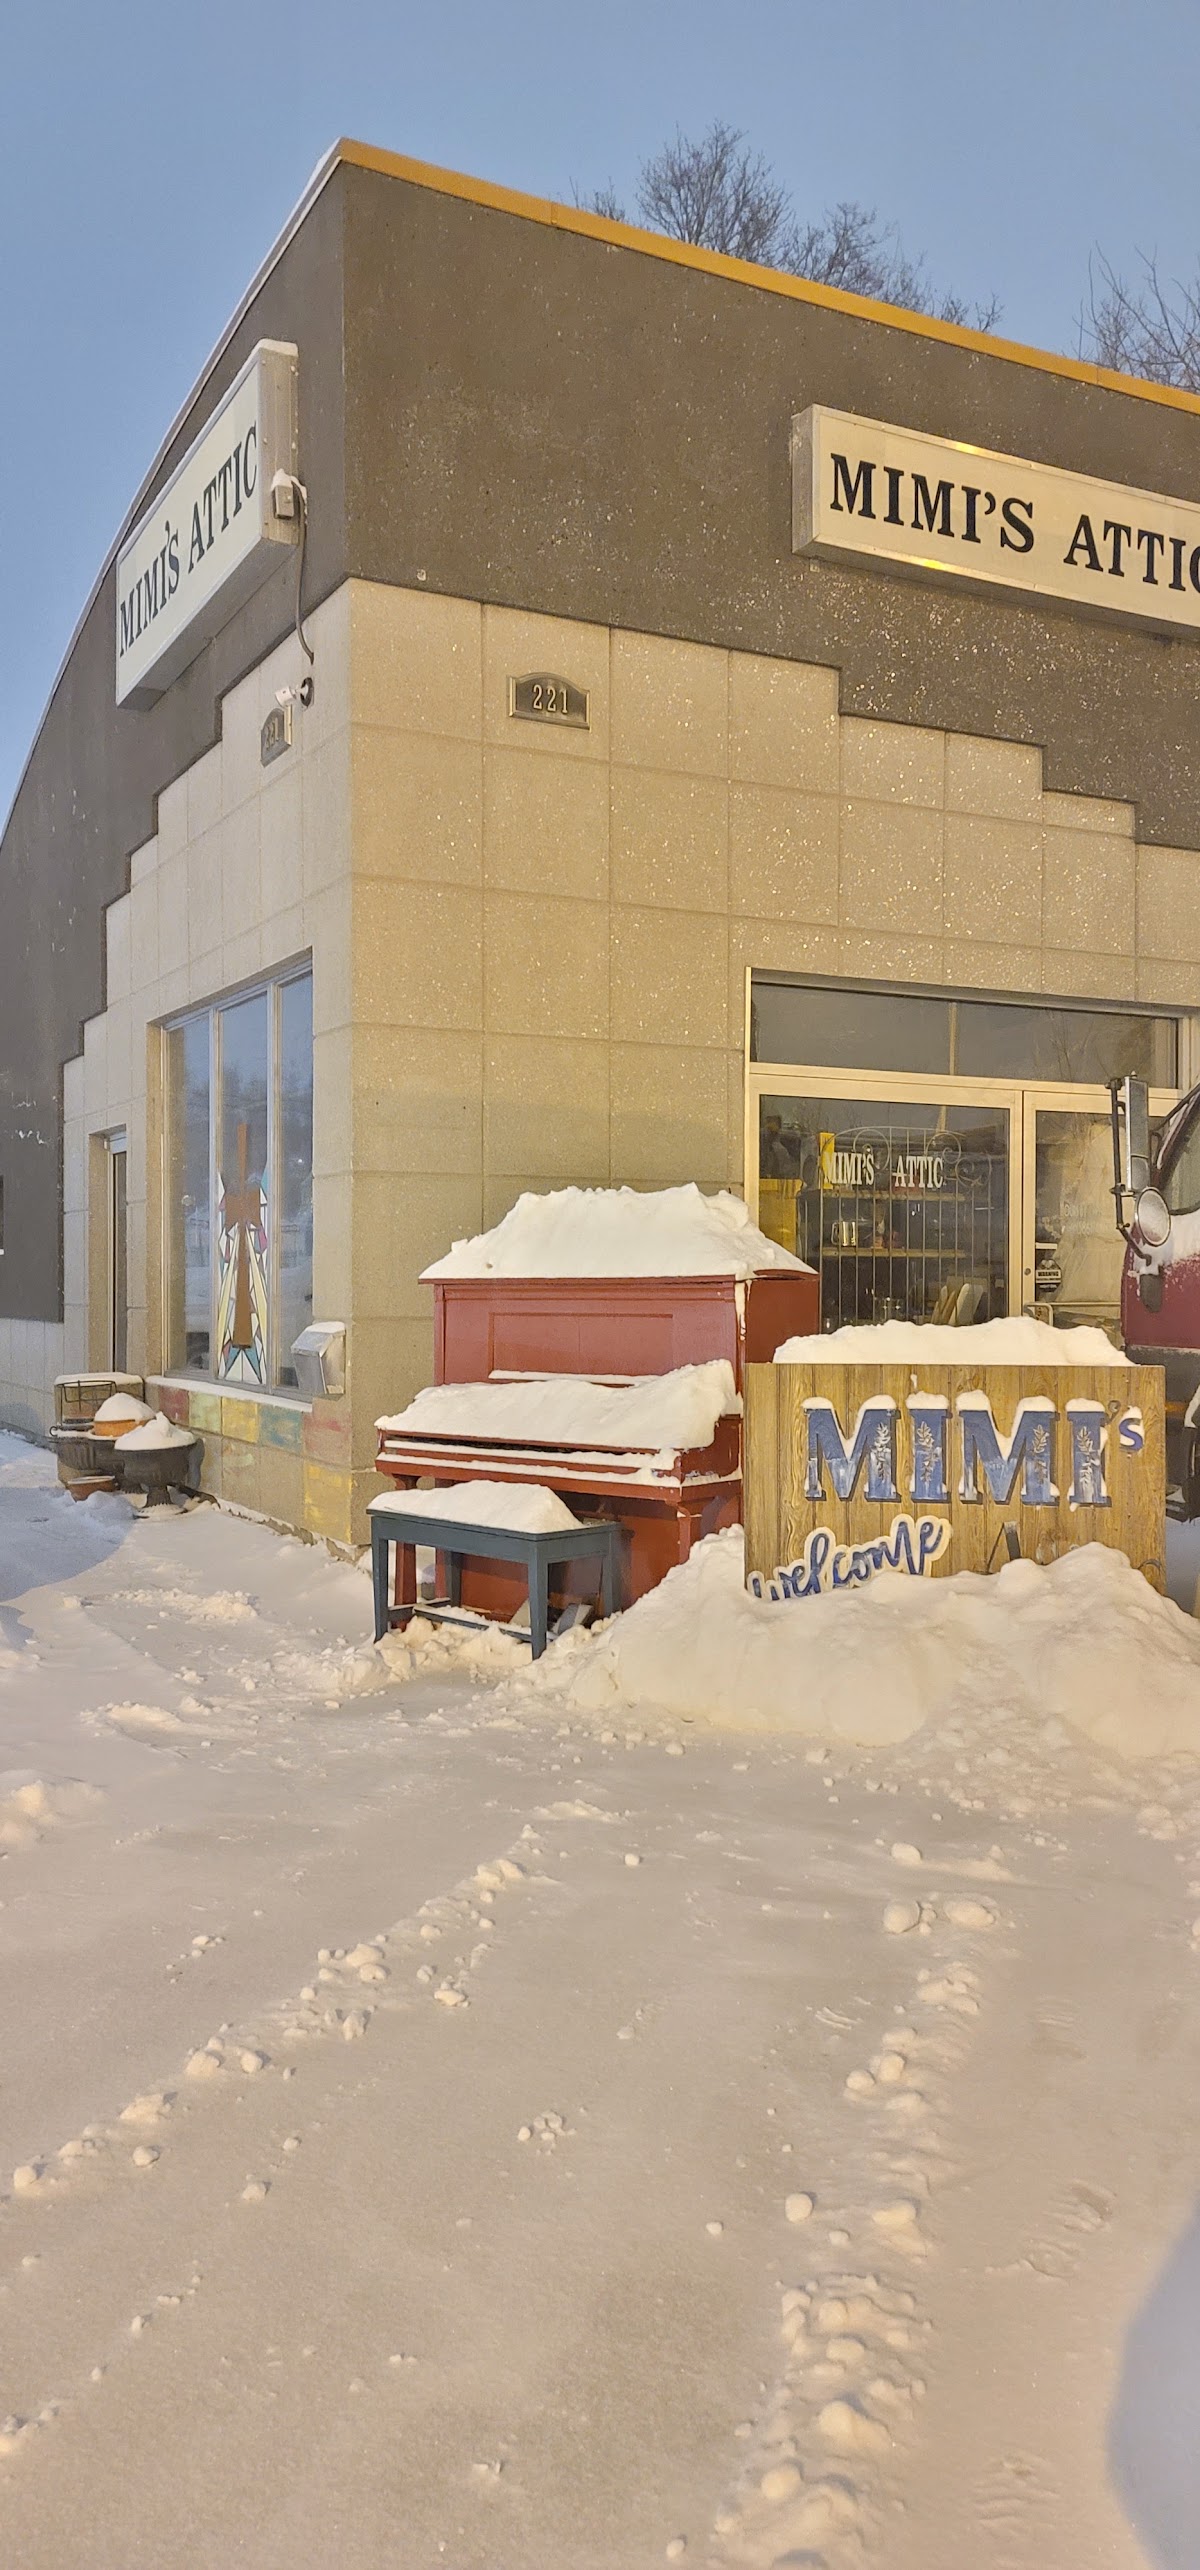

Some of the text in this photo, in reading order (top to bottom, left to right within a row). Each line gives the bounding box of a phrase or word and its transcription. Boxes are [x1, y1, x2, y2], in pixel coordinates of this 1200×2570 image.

[829, 453, 1035, 554] MIMI'S
[119, 420, 258, 659] MIMI'S ATTIC
[532, 684, 568, 714] 221
[822, 1151, 943, 1188] MIMI'S ATTIC
